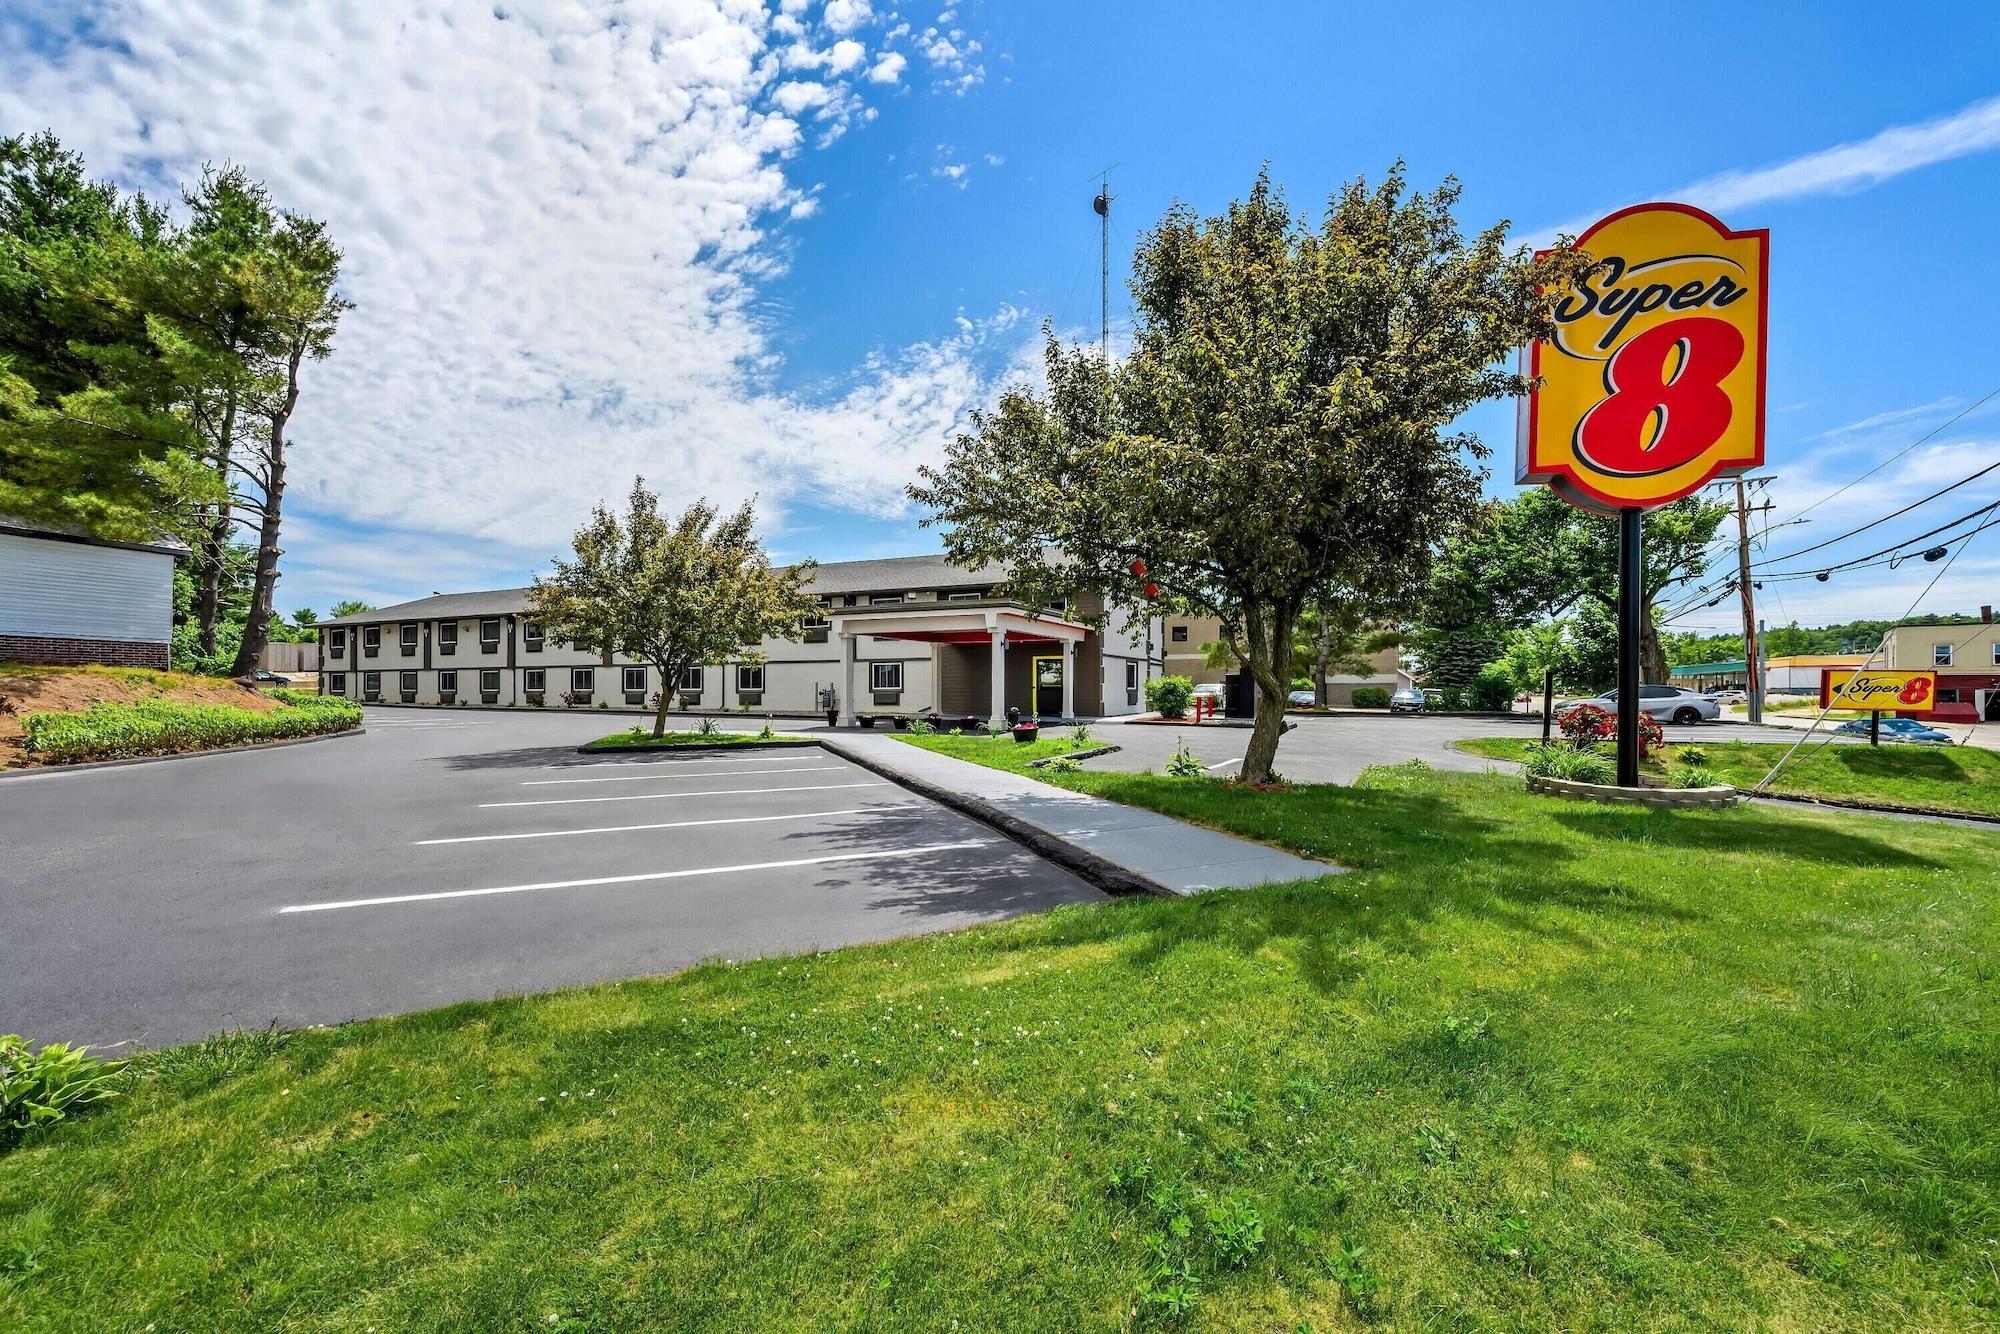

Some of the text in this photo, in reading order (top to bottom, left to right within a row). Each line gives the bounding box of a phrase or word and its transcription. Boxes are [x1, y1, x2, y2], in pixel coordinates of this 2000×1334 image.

[1554, 256, 1748, 349] Super
[1572, 317, 1745, 478] 8
[1850, 677, 1931, 704] Super 8
